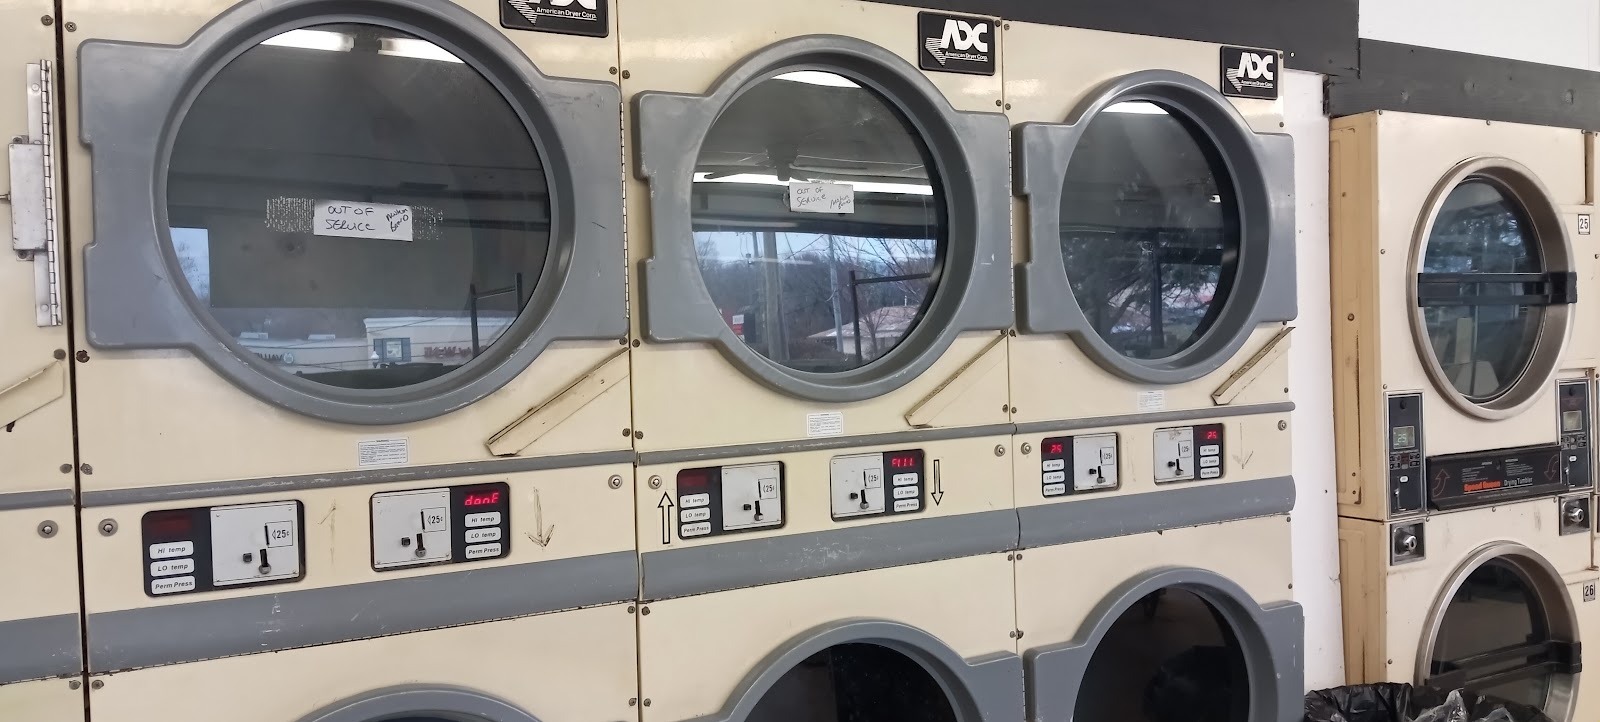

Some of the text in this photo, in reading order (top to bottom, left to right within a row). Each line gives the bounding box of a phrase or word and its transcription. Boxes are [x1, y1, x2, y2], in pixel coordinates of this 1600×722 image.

[536, 7, 564, 15] American
[565, 9, 581, 17] Dryer
[940, 19, 988, 52] ADC
[1237, 52, 1273, 80] ADC
[328, 206, 374, 216] OUT OF
[1580, 218, 1588, 229] 25
[1208, 431, 1217, 439] 25
[1051, 444, 1062, 453] 25
[1585, 584, 1594, 596] 26
